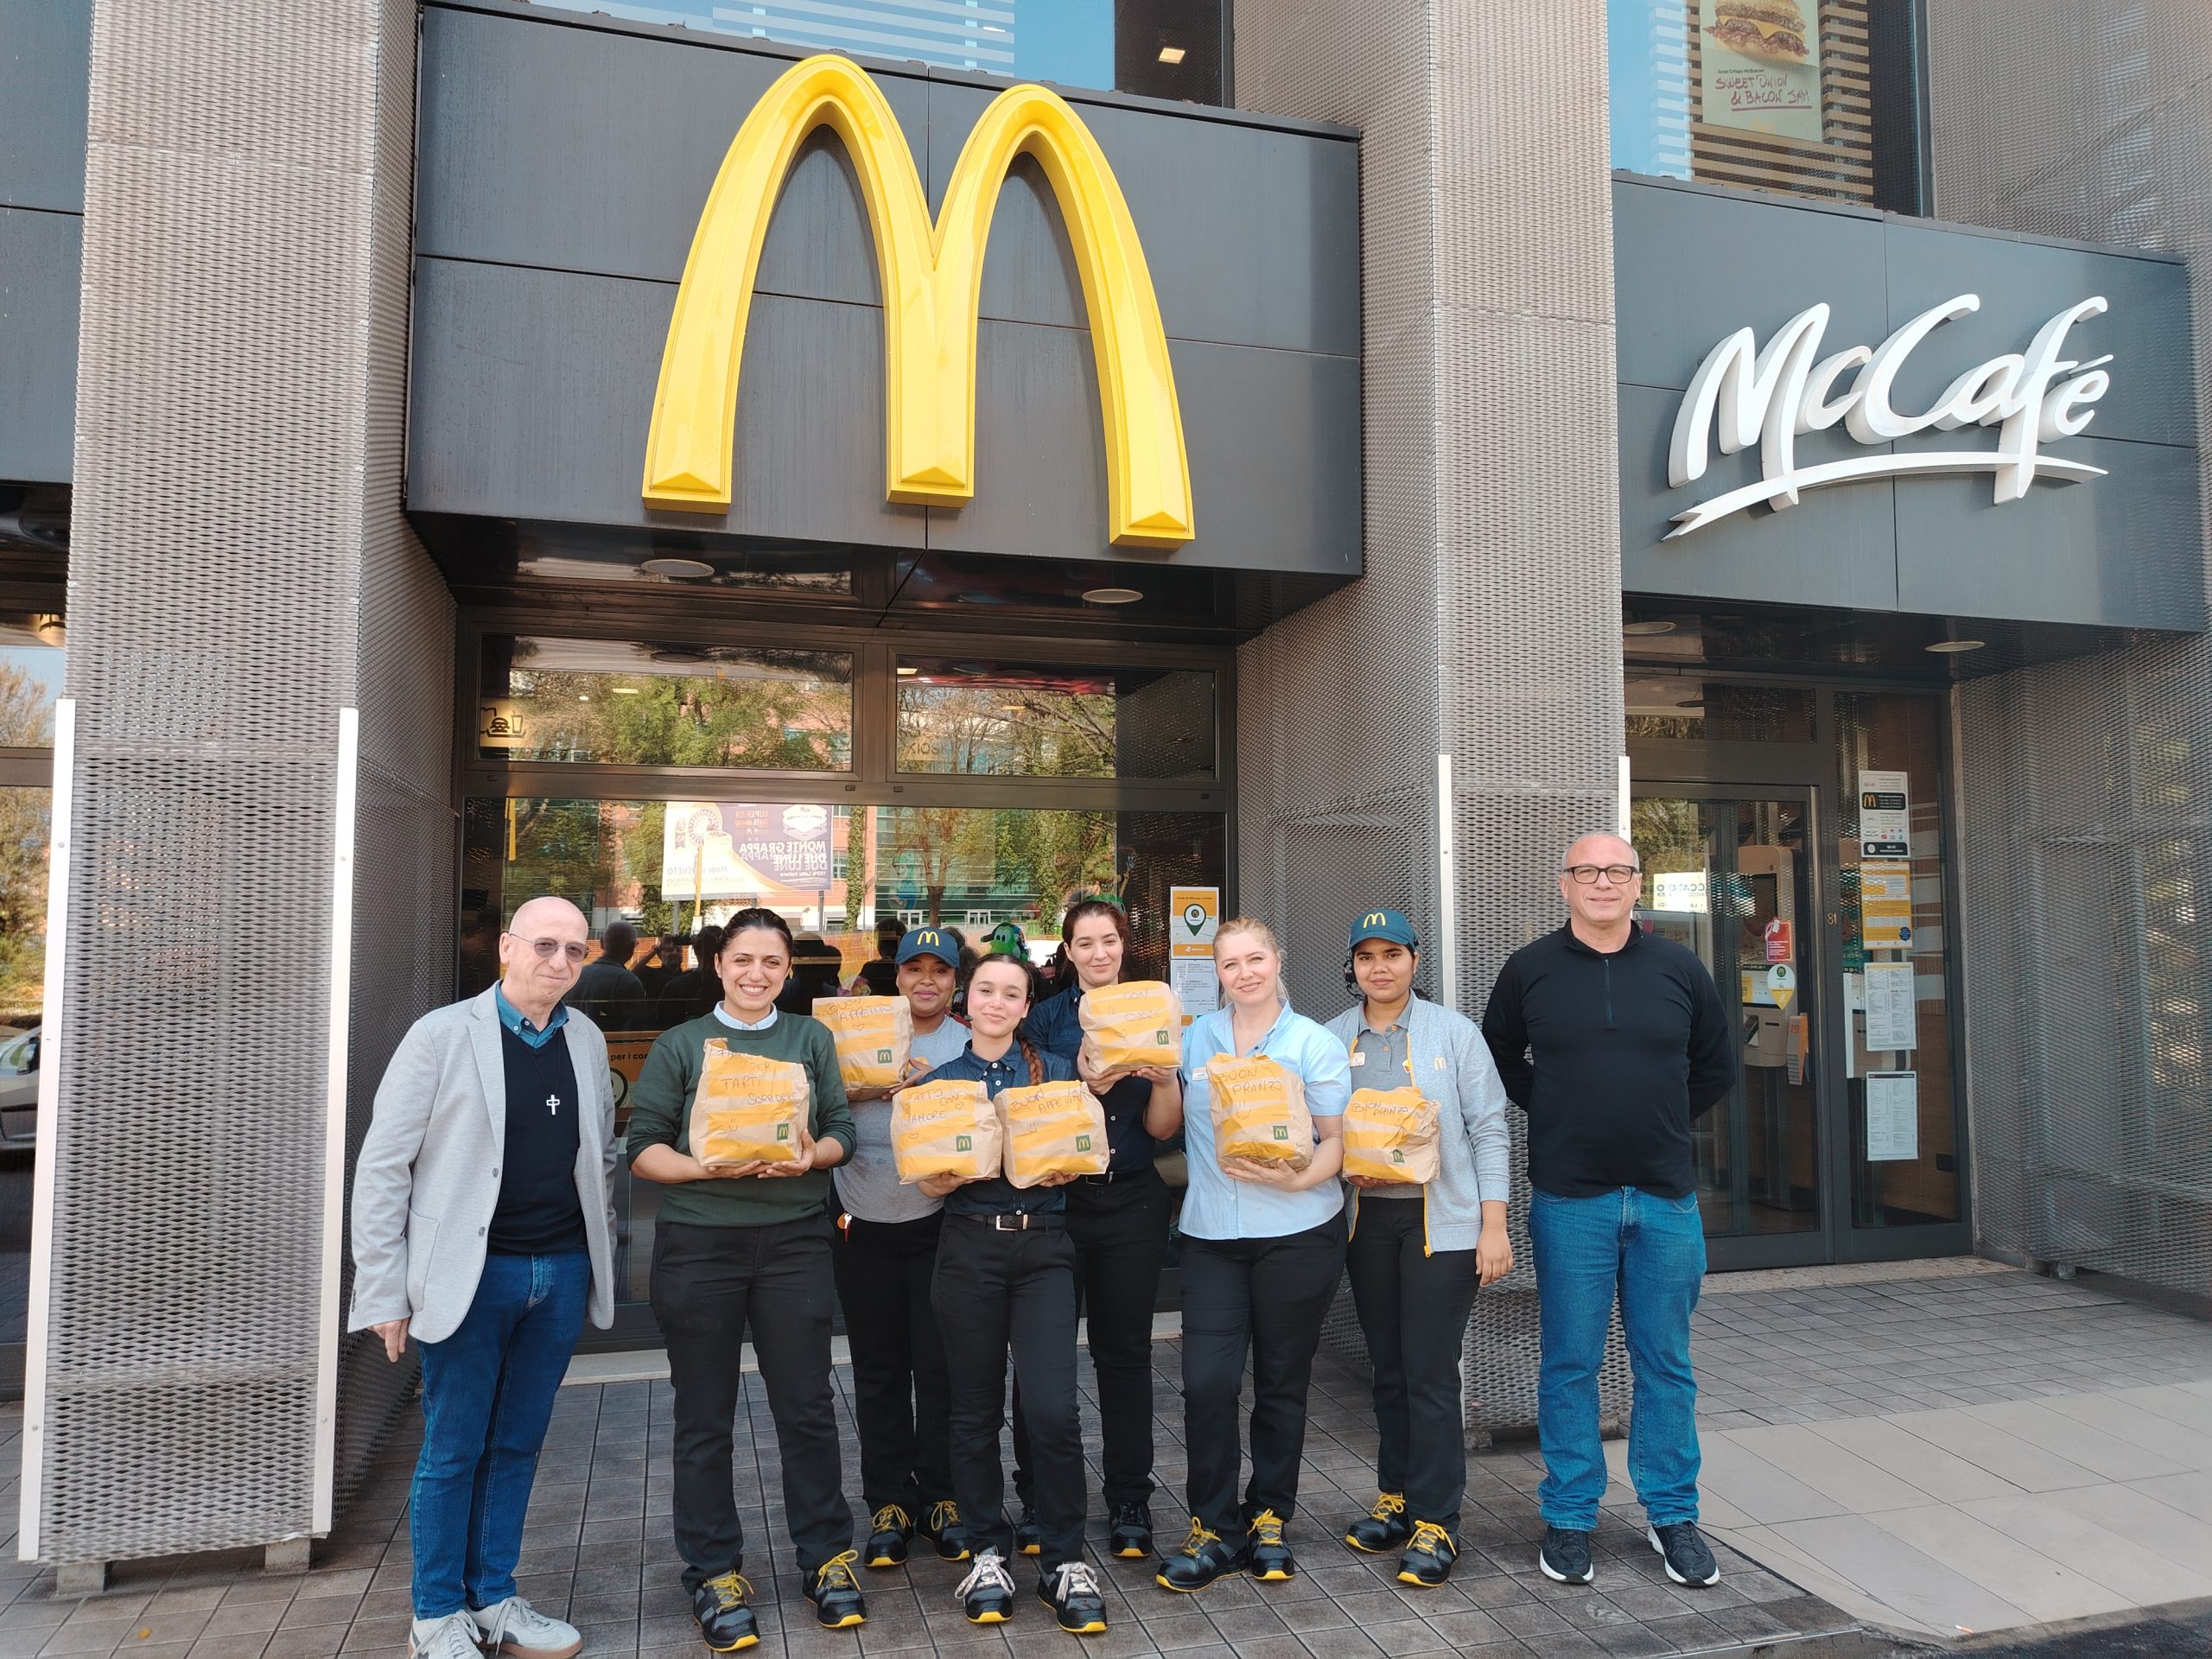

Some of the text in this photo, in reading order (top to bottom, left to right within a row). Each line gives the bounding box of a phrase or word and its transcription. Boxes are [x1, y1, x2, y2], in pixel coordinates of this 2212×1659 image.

[1715, 73, 1788, 90] SWEET ONION
[1731, 89, 1810, 105] & BACON JAM
[642, 54, 1196, 549] M
[1669, 293, 2113, 512] McCafé
[1363, 912, 1386, 929] M
[1827, 912, 1837, 925] 81
[917, 931, 939, 946] M
[721, 1074, 761, 1089] FARTI
[1217, 1066, 1257, 1083] BUON
[1232, 1080, 1283, 1096] PRANZO
[907, 1089, 944, 1103] FATTO
[939, 1094, 960, 1107] CON
[1010, 1088, 1045, 1112] BUON
[1352, 1102, 1382, 1113] BUON
[1373, 1106, 1409, 1117] PRANZO
[911, 1110, 947, 1123] AMORE
